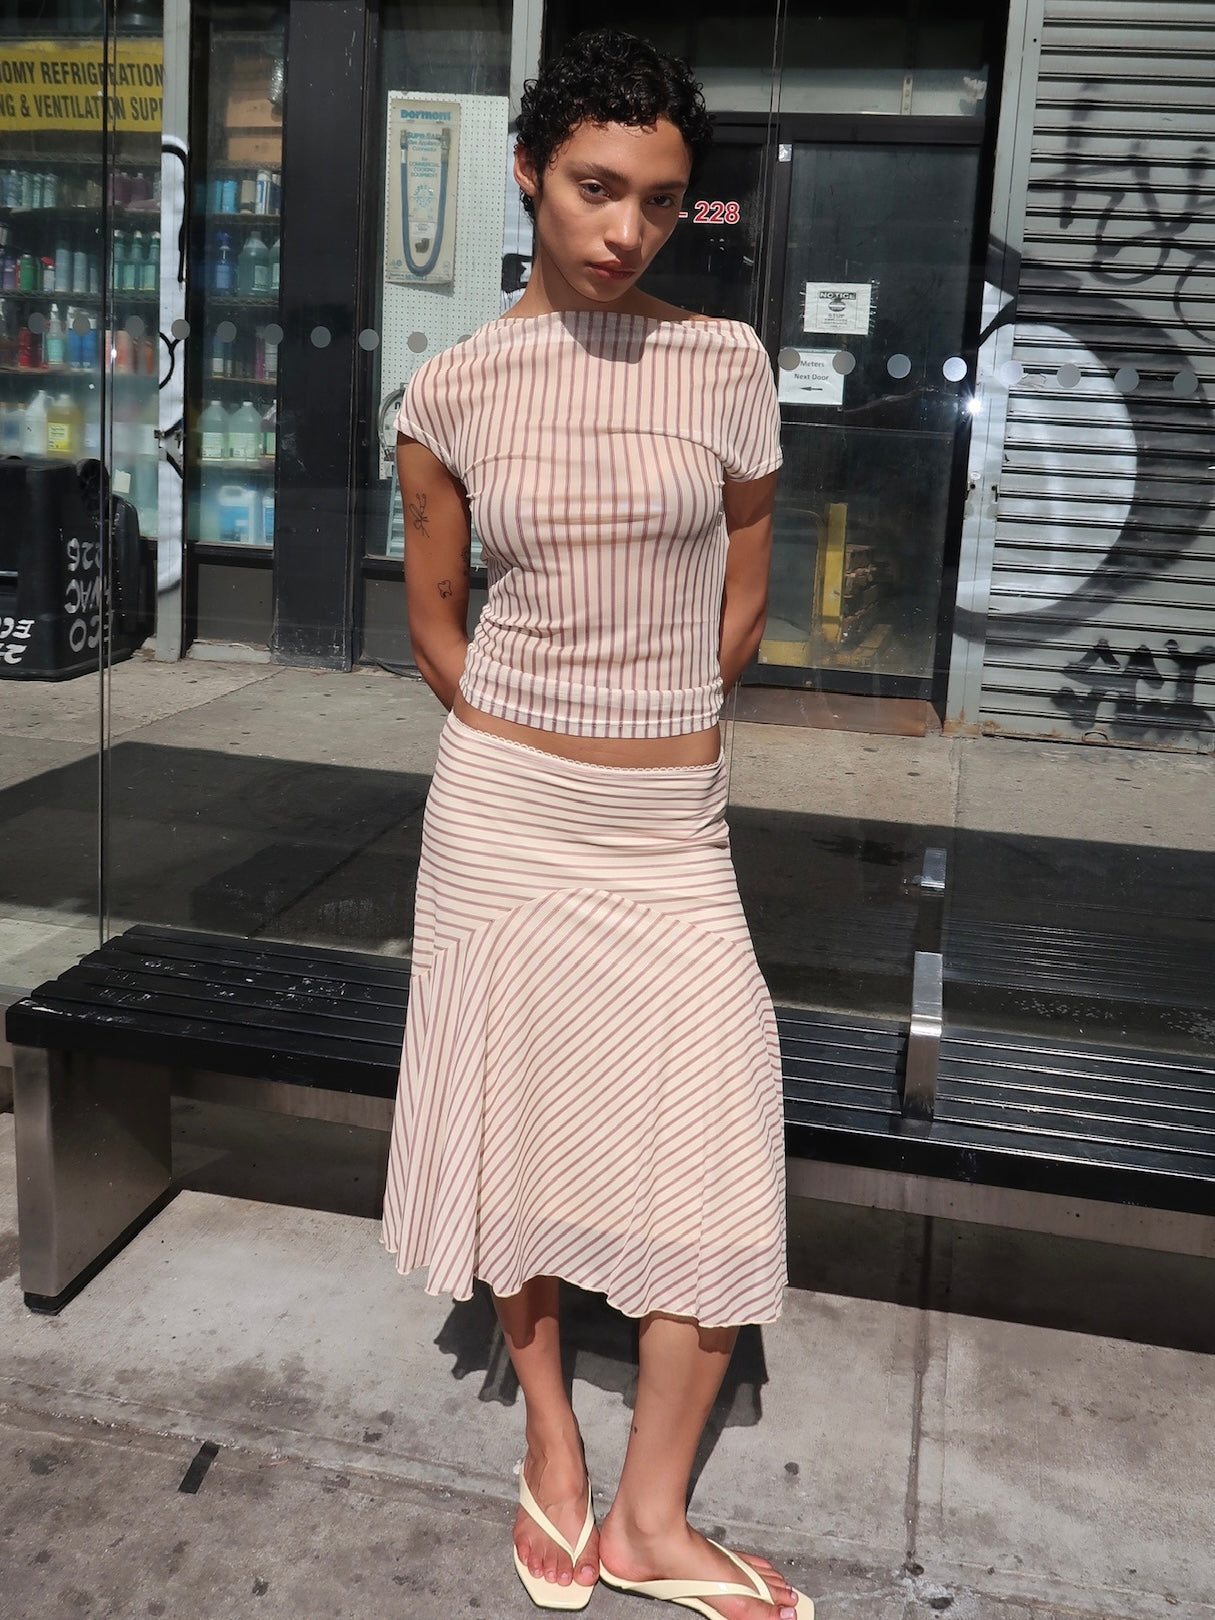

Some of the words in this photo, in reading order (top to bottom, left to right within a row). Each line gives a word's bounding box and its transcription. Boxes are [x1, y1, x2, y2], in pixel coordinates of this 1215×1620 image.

[0, 61, 35, 84] OMY
[20, 94, 31, 117] &
[693, 201, 740, 225] 228
[820, 291, 855, 299] NOTICE
